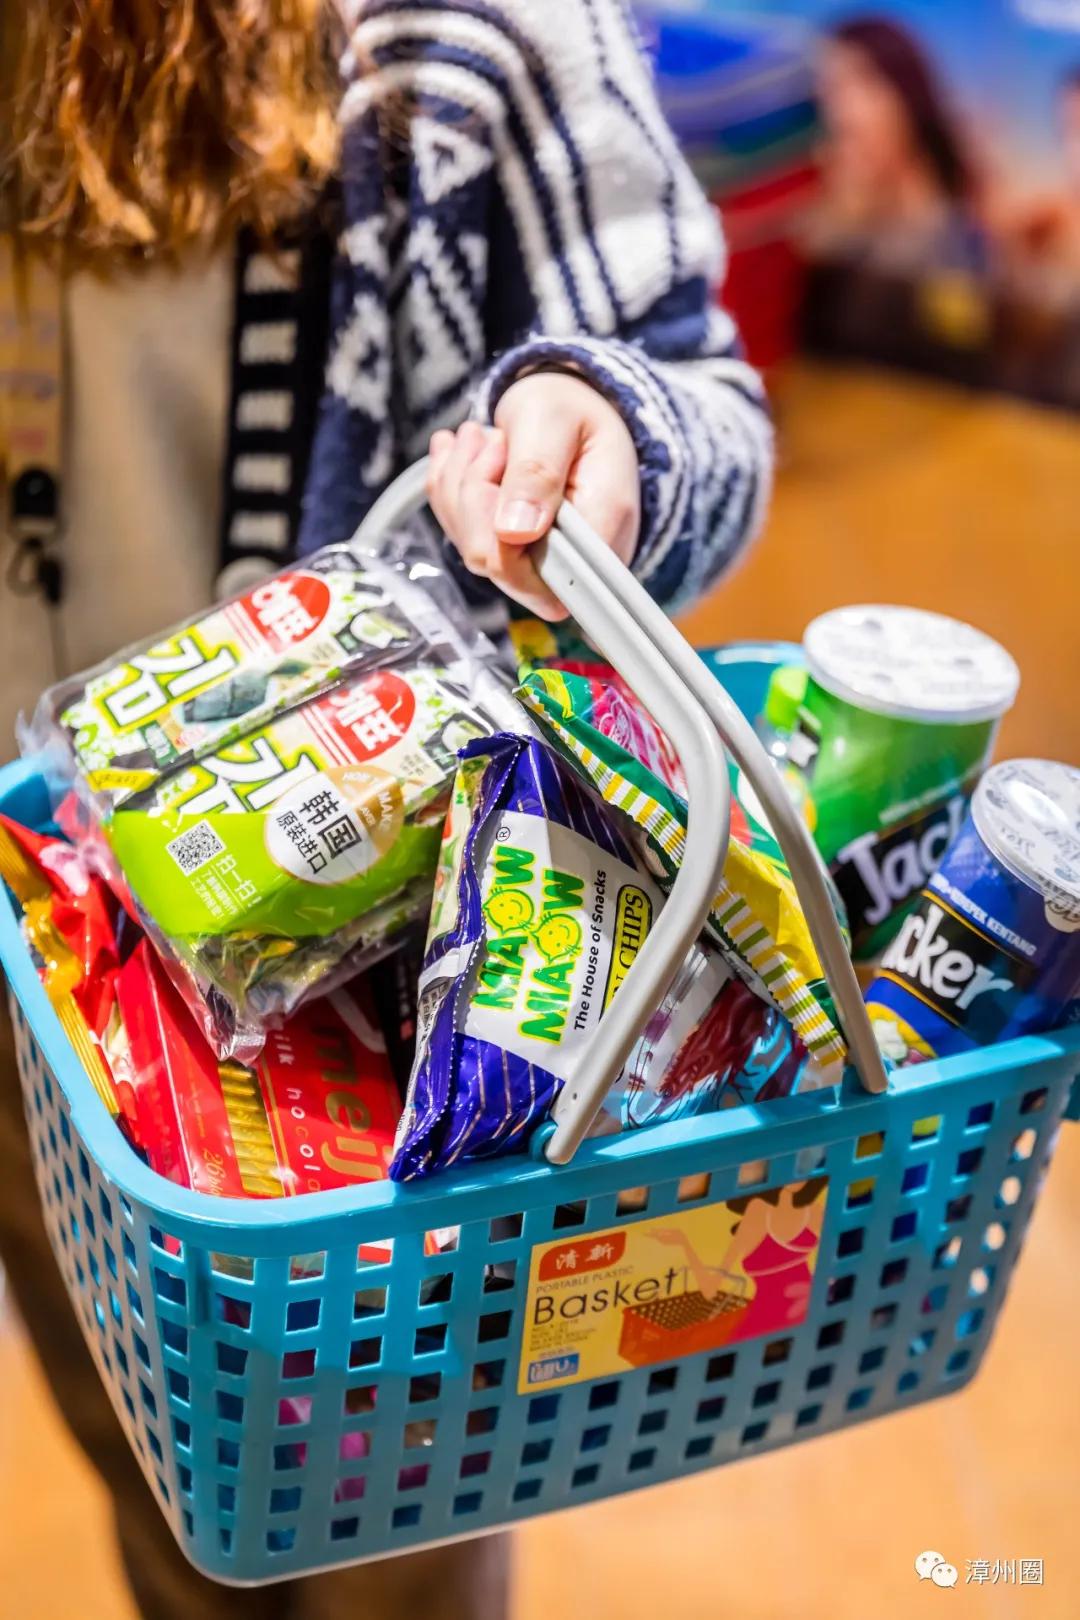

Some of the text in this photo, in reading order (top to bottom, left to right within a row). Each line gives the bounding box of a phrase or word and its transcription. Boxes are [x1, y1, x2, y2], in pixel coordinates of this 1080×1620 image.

[103, 634, 240, 728] 김
[275, 810, 327, 875] 原装进口
[298, 790, 362, 859] 韩国
[470, 844, 536, 1011] MIAOW
[519, 868, 586, 1043] MIAOW
[574, 869, 607, 1031] The House of Snacks
[619, 892, 644, 970] CHIPS
[880, 903, 1014, 1010] cker
[534, 1267, 679, 1326] Basket
[536, 1264, 634, 1294] PORTABLE PLASTIC
